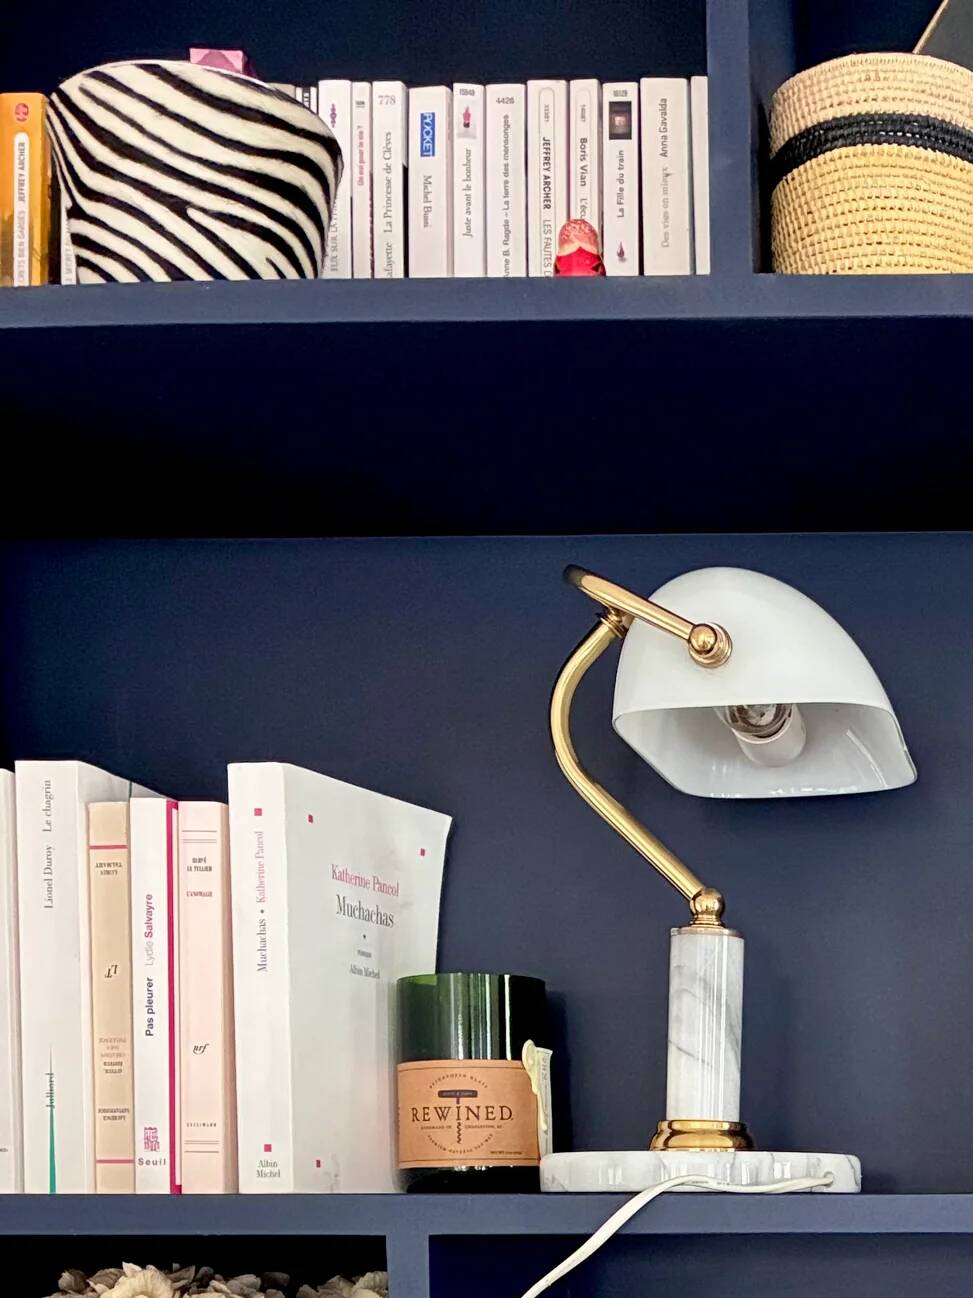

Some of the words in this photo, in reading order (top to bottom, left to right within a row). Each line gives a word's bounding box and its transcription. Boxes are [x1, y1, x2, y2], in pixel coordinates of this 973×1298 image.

[658, 97, 668, 134] Gavalda
[383, 131, 393, 164] Clèves
[421, 112, 436, 157] POCKET
[502, 114, 511, 162] mensonges
[659, 134, 668, 158] Anna
[542, 136, 552, 173] JEFFREY
[579, 137, 588, 164] Boris
[617, 149, 625, 167] train
[383, 165, 393, 179] de
[462, 148, 472, 181] bonheur
[579, 164, 588, 187] Vian
[423, 174, 433, 204] Michel
[462, 180, 472, 191] le
[617, 171, 625, 186] du
[383, 179, 393, 220] Princesse
[462, 191, 472, 217] avant
[503, 196, 510, 211] La
[542, 174, 552, 211] ARCHER
[616, 186, 625, 206] Fille
[543, 219, 552, 232] LES
[617, 206, 625, 218] La
[383, 221, 393, 233] La
[462, 218, 474, 238] Juste
[503, 218, 512, 247] Ragde
[661, 231, 669, 248] Des
[503, 247, 510, 257] B.
[543, 233, 552, 269] FAUTES
[42, 779, 54, 818] chagrin
[42, 819, 52, 833] Le
[254, 830, 265, 857] Pancol
[43, 844, 56, 876] Duroy
[43, 877, 54, 909] Lionel
[255, 860, 265, 904] Katherine
[331, 863, 371, 889] Katherine
[372, 875, 400, 897] Pancol
[144, 893, 155, 938] Salvayre
[335, 893, 395, 928] Muchachas
[145, 939, 155, 967] Lydie
[256, 918, 268, 973] Muchachas
[145, 976, 156, 1016] pleurer
[145, 1017, 154, 1037] Pas
[137, 1157, 166, 1166] Seuil
[255, 1169, 281, 1179] Michel
[257, 1159, 278, 1169] Albin
